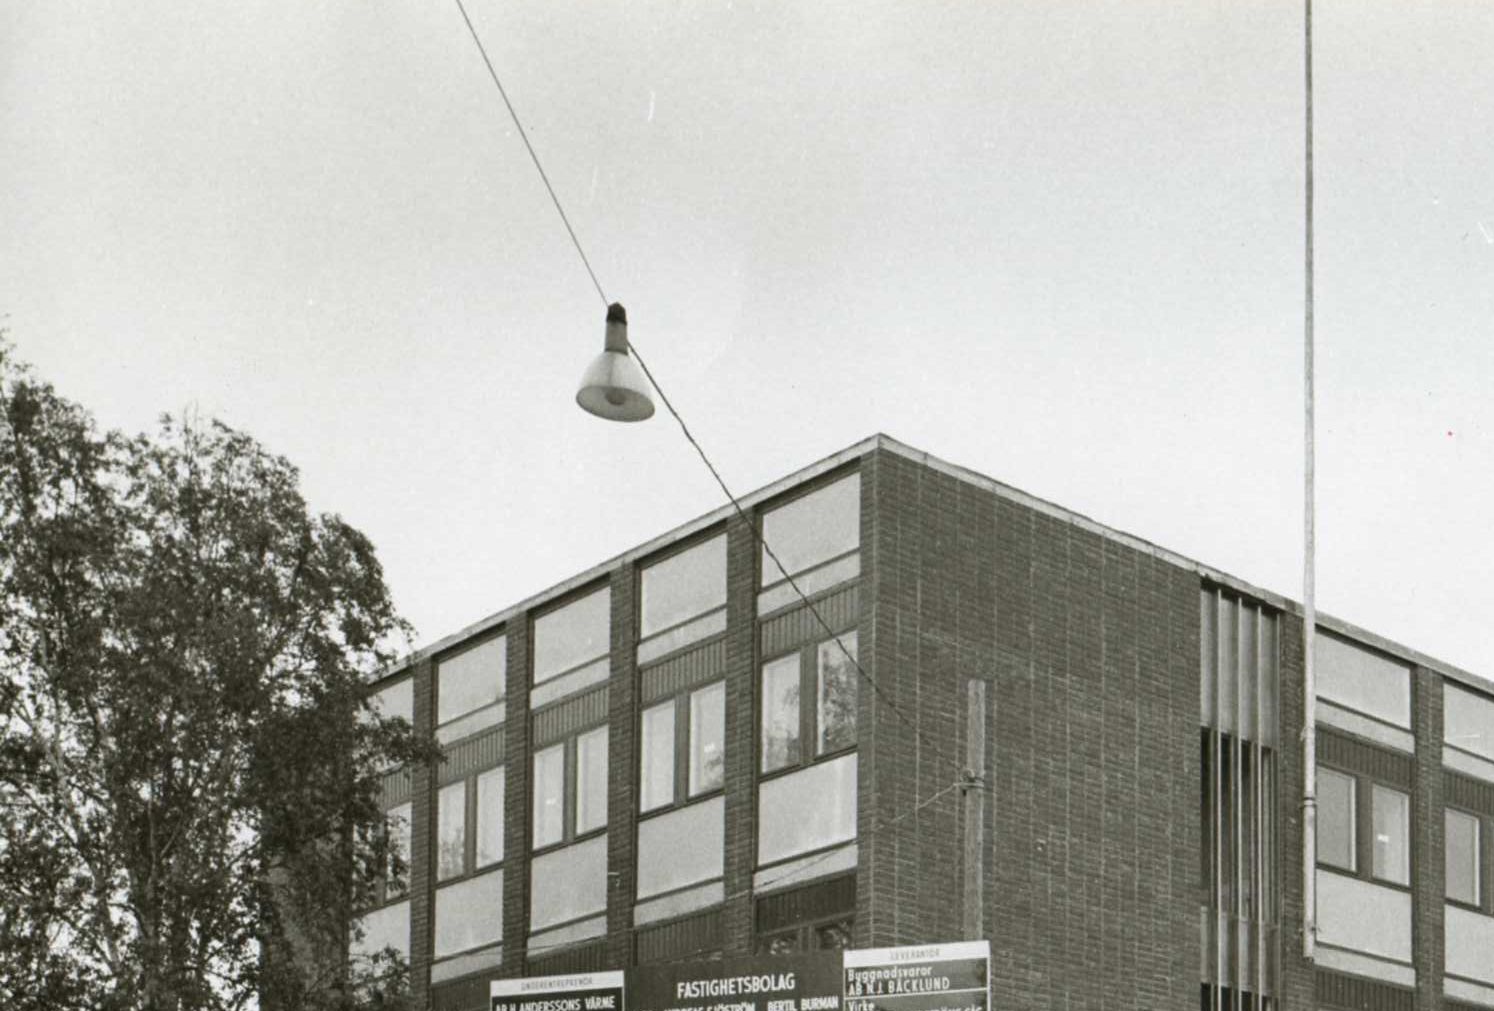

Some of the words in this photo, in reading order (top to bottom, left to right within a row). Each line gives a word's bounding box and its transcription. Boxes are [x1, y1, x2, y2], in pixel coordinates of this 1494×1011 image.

[848, 966, 933, 983] Byggnadsvaror
[677, 973, 795, 999] FASTIGHETSBOLAG
[848, 982, 862, 996] AB
[801, 996, 839, 1011] BURMAN
